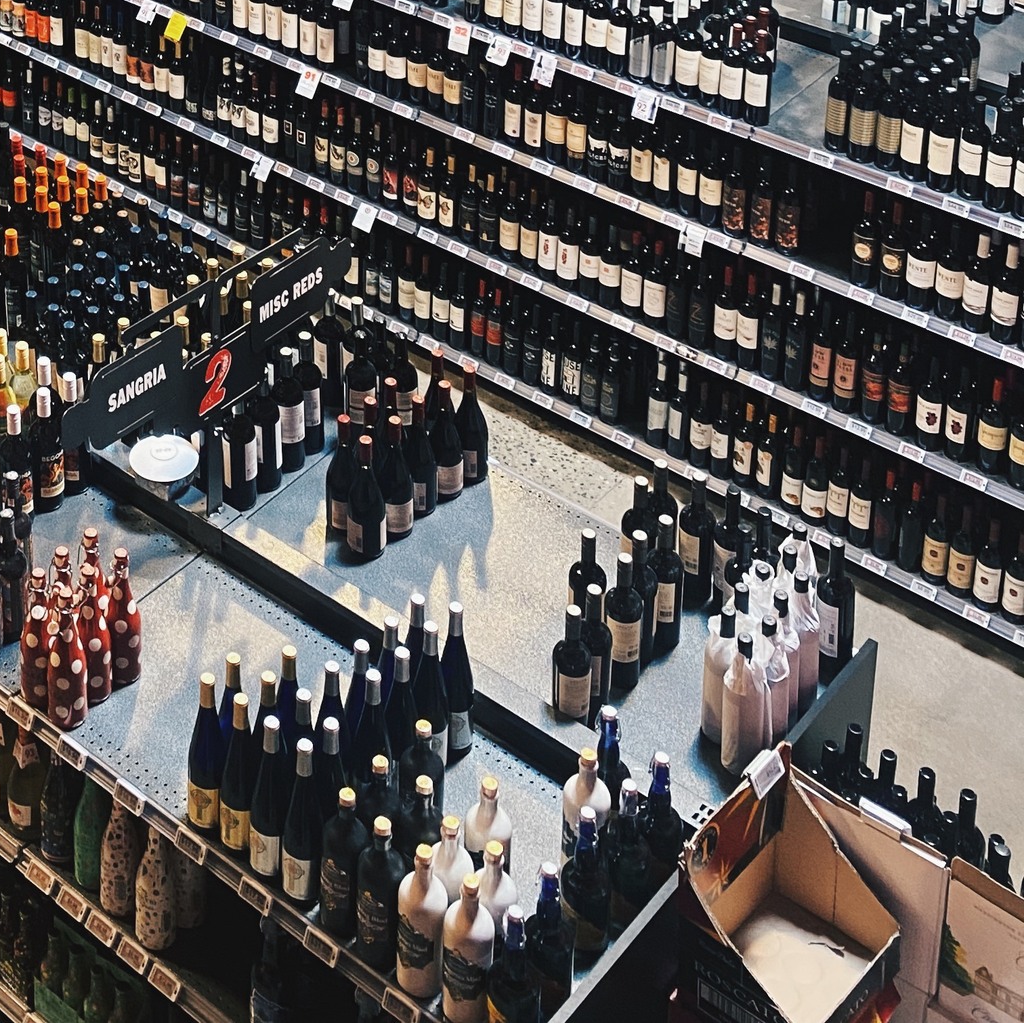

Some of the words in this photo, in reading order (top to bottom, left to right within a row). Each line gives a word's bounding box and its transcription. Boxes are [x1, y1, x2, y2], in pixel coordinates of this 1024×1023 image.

[454, 26, 467, 37] 92
[304, 71, 317, 82] 91
[636, 102, 647, 113] 92
[259, 290, 289, 324] MISC
[293, 267, 323, 301] REDS
[108, 363, 167, 413] SANGRIA
[199, 348, 232, 416] 2
